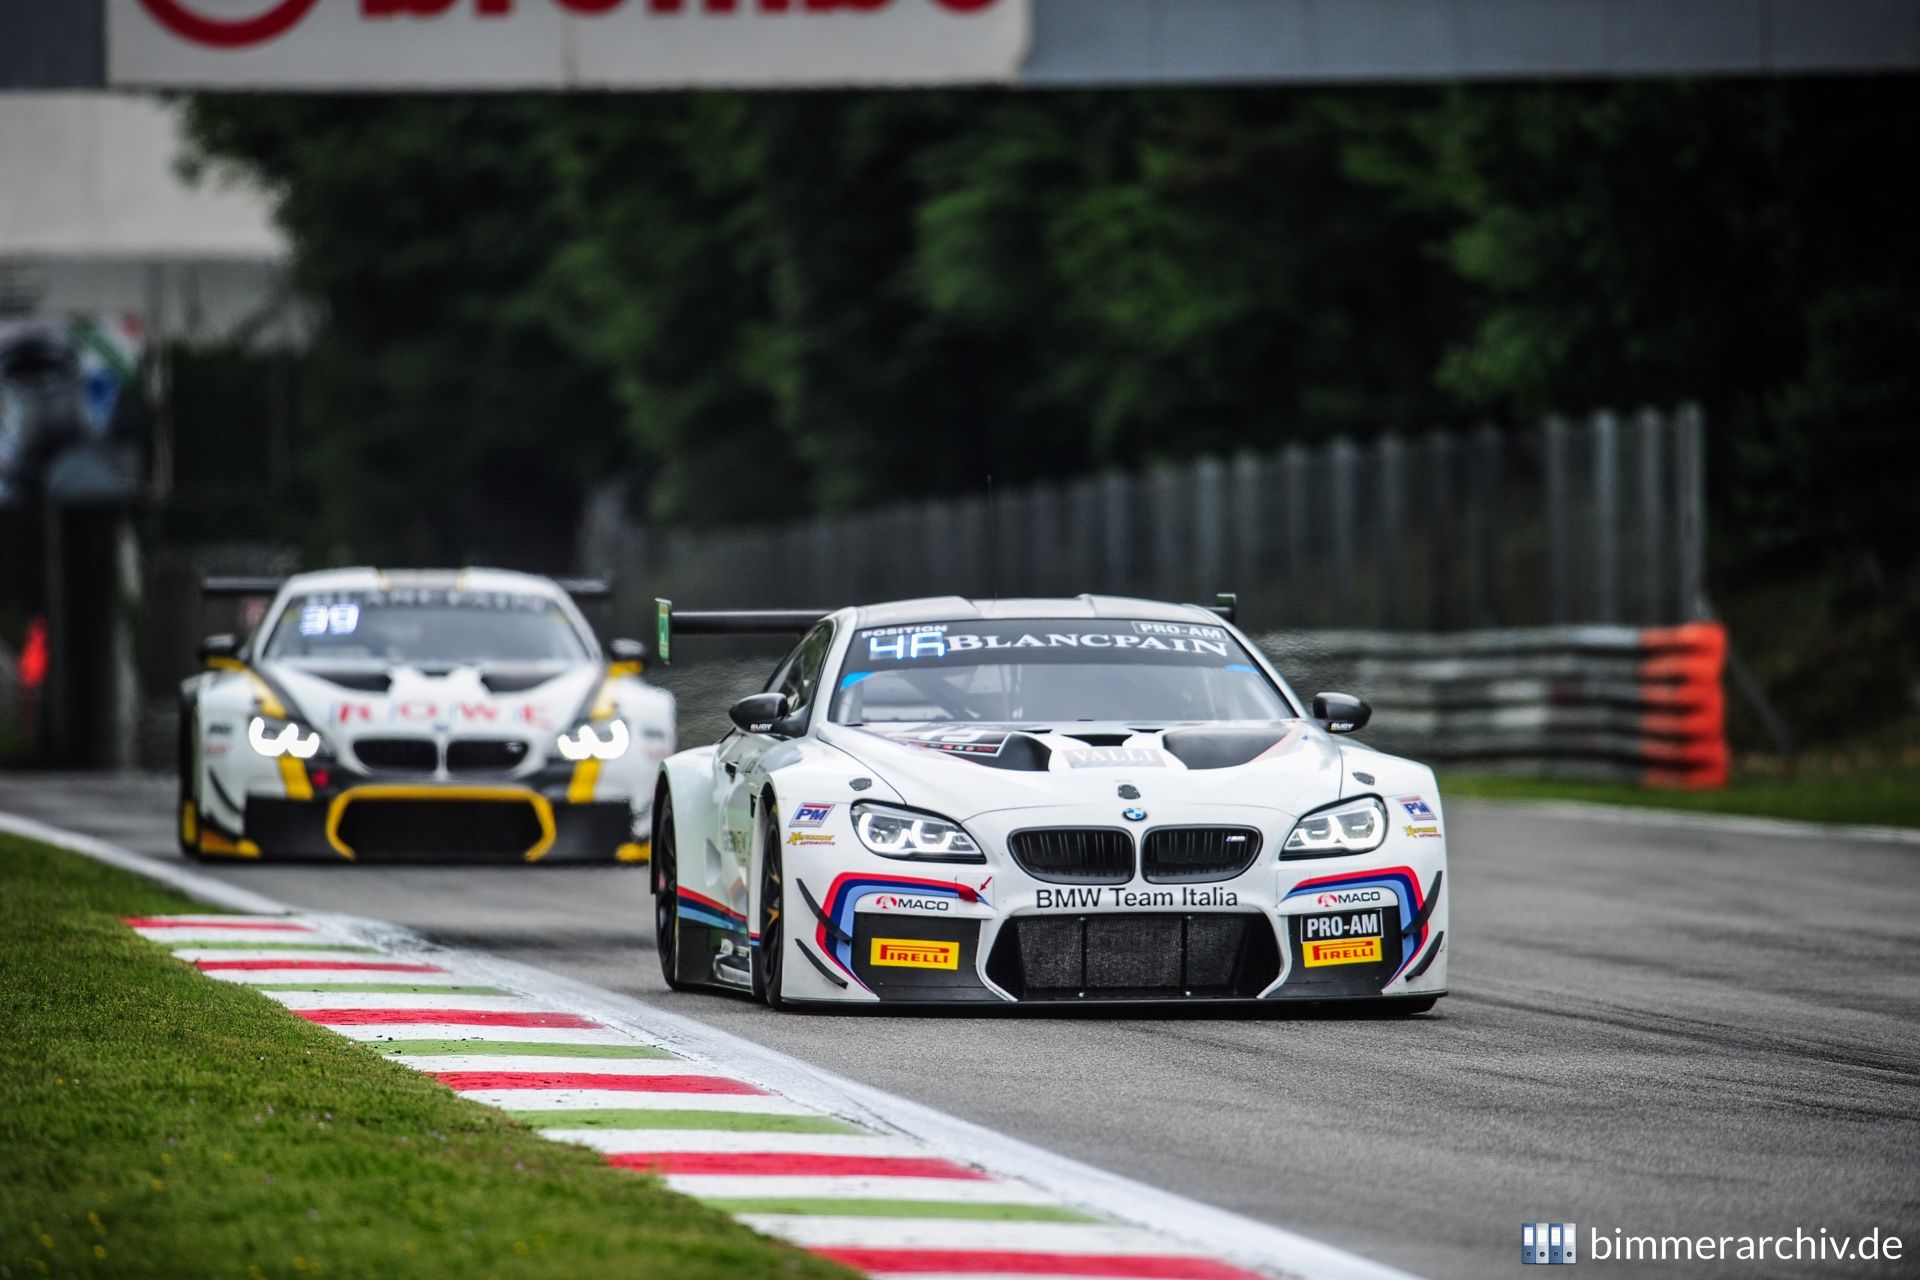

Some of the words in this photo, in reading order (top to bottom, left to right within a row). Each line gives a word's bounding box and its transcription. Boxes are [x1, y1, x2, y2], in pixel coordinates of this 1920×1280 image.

[861, 624, 948, 638] POSITION
[1139, 623, 1222, 639] PRO-AM
[945, 633, 1228, 657] BLANCPAIN
[336, 700, 553, 731] ROWE
[795, 808, 828, 820] PM
[898, 898, 949, 911] MACO
[1036, 887, 1102, 908] BMW
[1108, 887, 1174, 907] Team
[1182, 886, 1238, 907] Italia
[1338, 891, 1381, 903] MACO
[1307, 913, 1378, 938] PRO-AM
[880, 944, 950, 964] PIRELLI
[1312, 940, 1374, 961] PIRELLI
